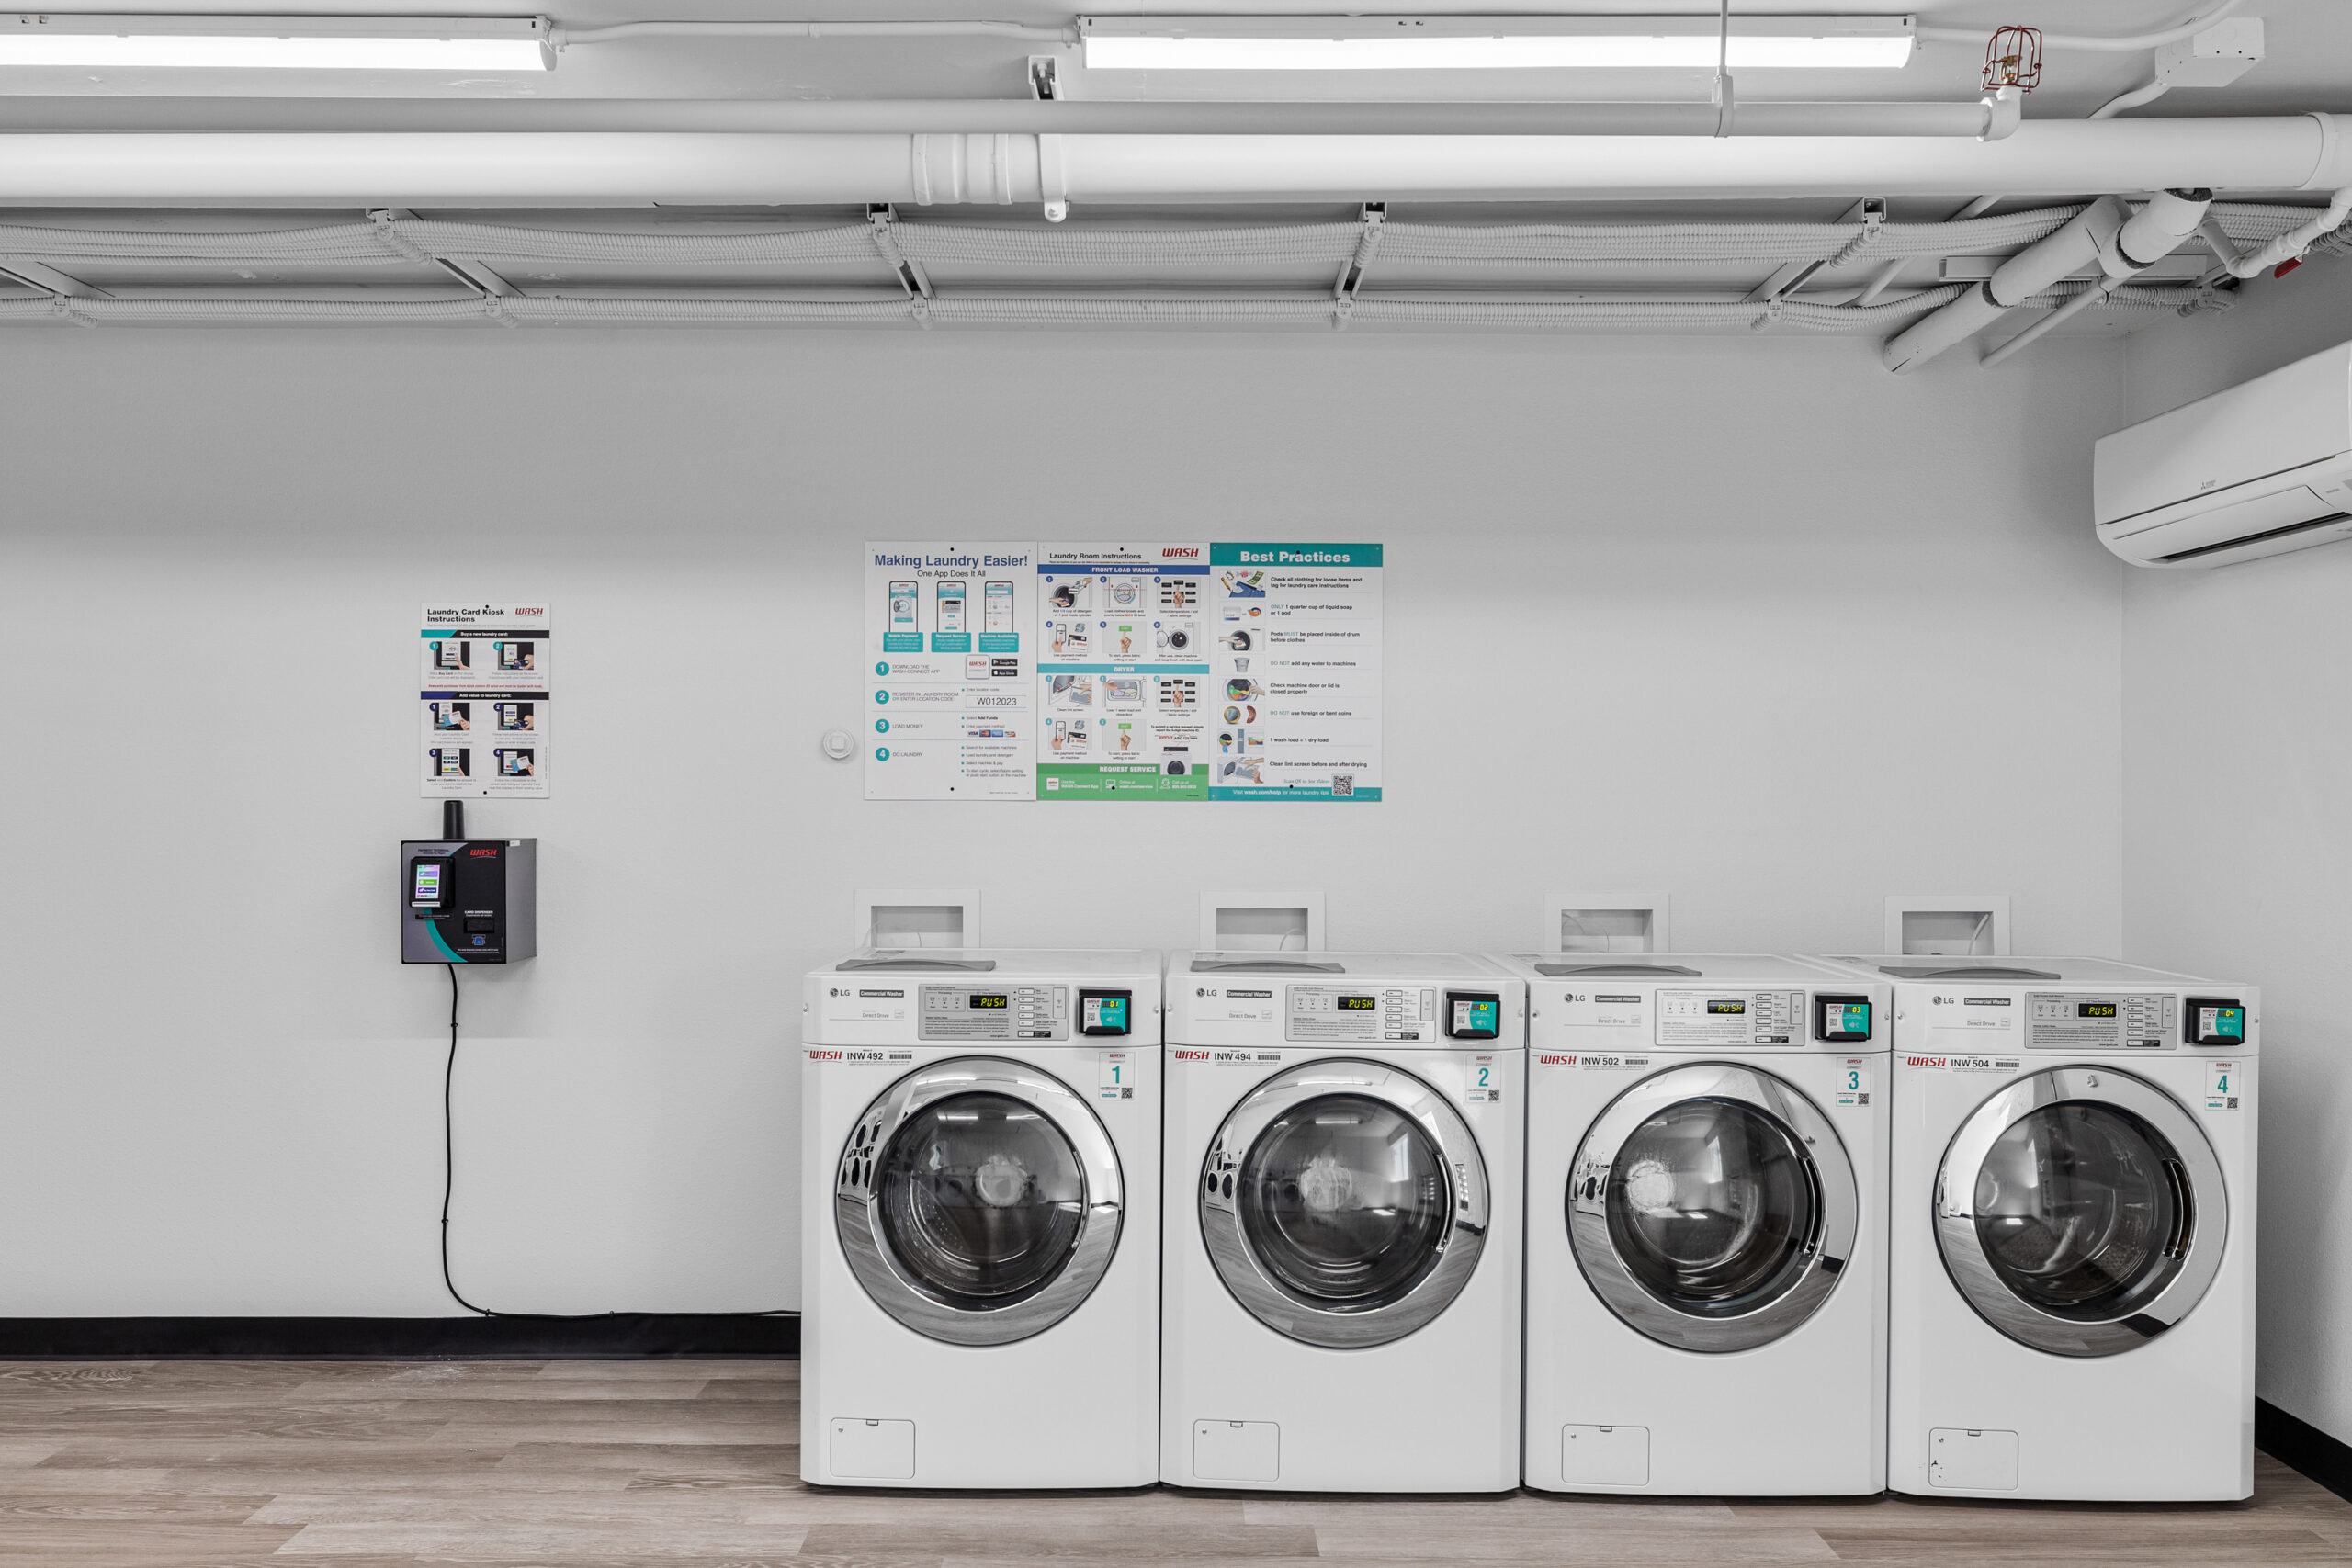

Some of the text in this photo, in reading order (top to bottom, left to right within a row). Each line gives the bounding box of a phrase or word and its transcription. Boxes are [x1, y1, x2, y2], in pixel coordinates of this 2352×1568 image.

[1162, 548, 1199, 558] WASH
[1240, 551, 1351, 562] Best Practices
[875, 555, 1028, 569] Making Laundry Easier!
[978, 697, 1017, 705] W012023
[981, 998, 1005, 1007] PUSH
[1349, 999, 1373, 1008] PUSH
[1718, 1004, 1742, 1012] PUSH
[2089, 1007, 2113, 1015] PUSH
[809, 1051, 842, 1059] WASH
[1175, 1051, 1209, 1060] WASH
[1540, 1055, 1577, 1065] WASH
[1907, 1057, 1946, 1066] WASH
[1112, 1066, 1120, 1083] 1
[1479, 1068, 1488, 1086] 2
[1849, 1071, 1859, 1089] 3
[2218, 1075, 2228, 1093] 4
